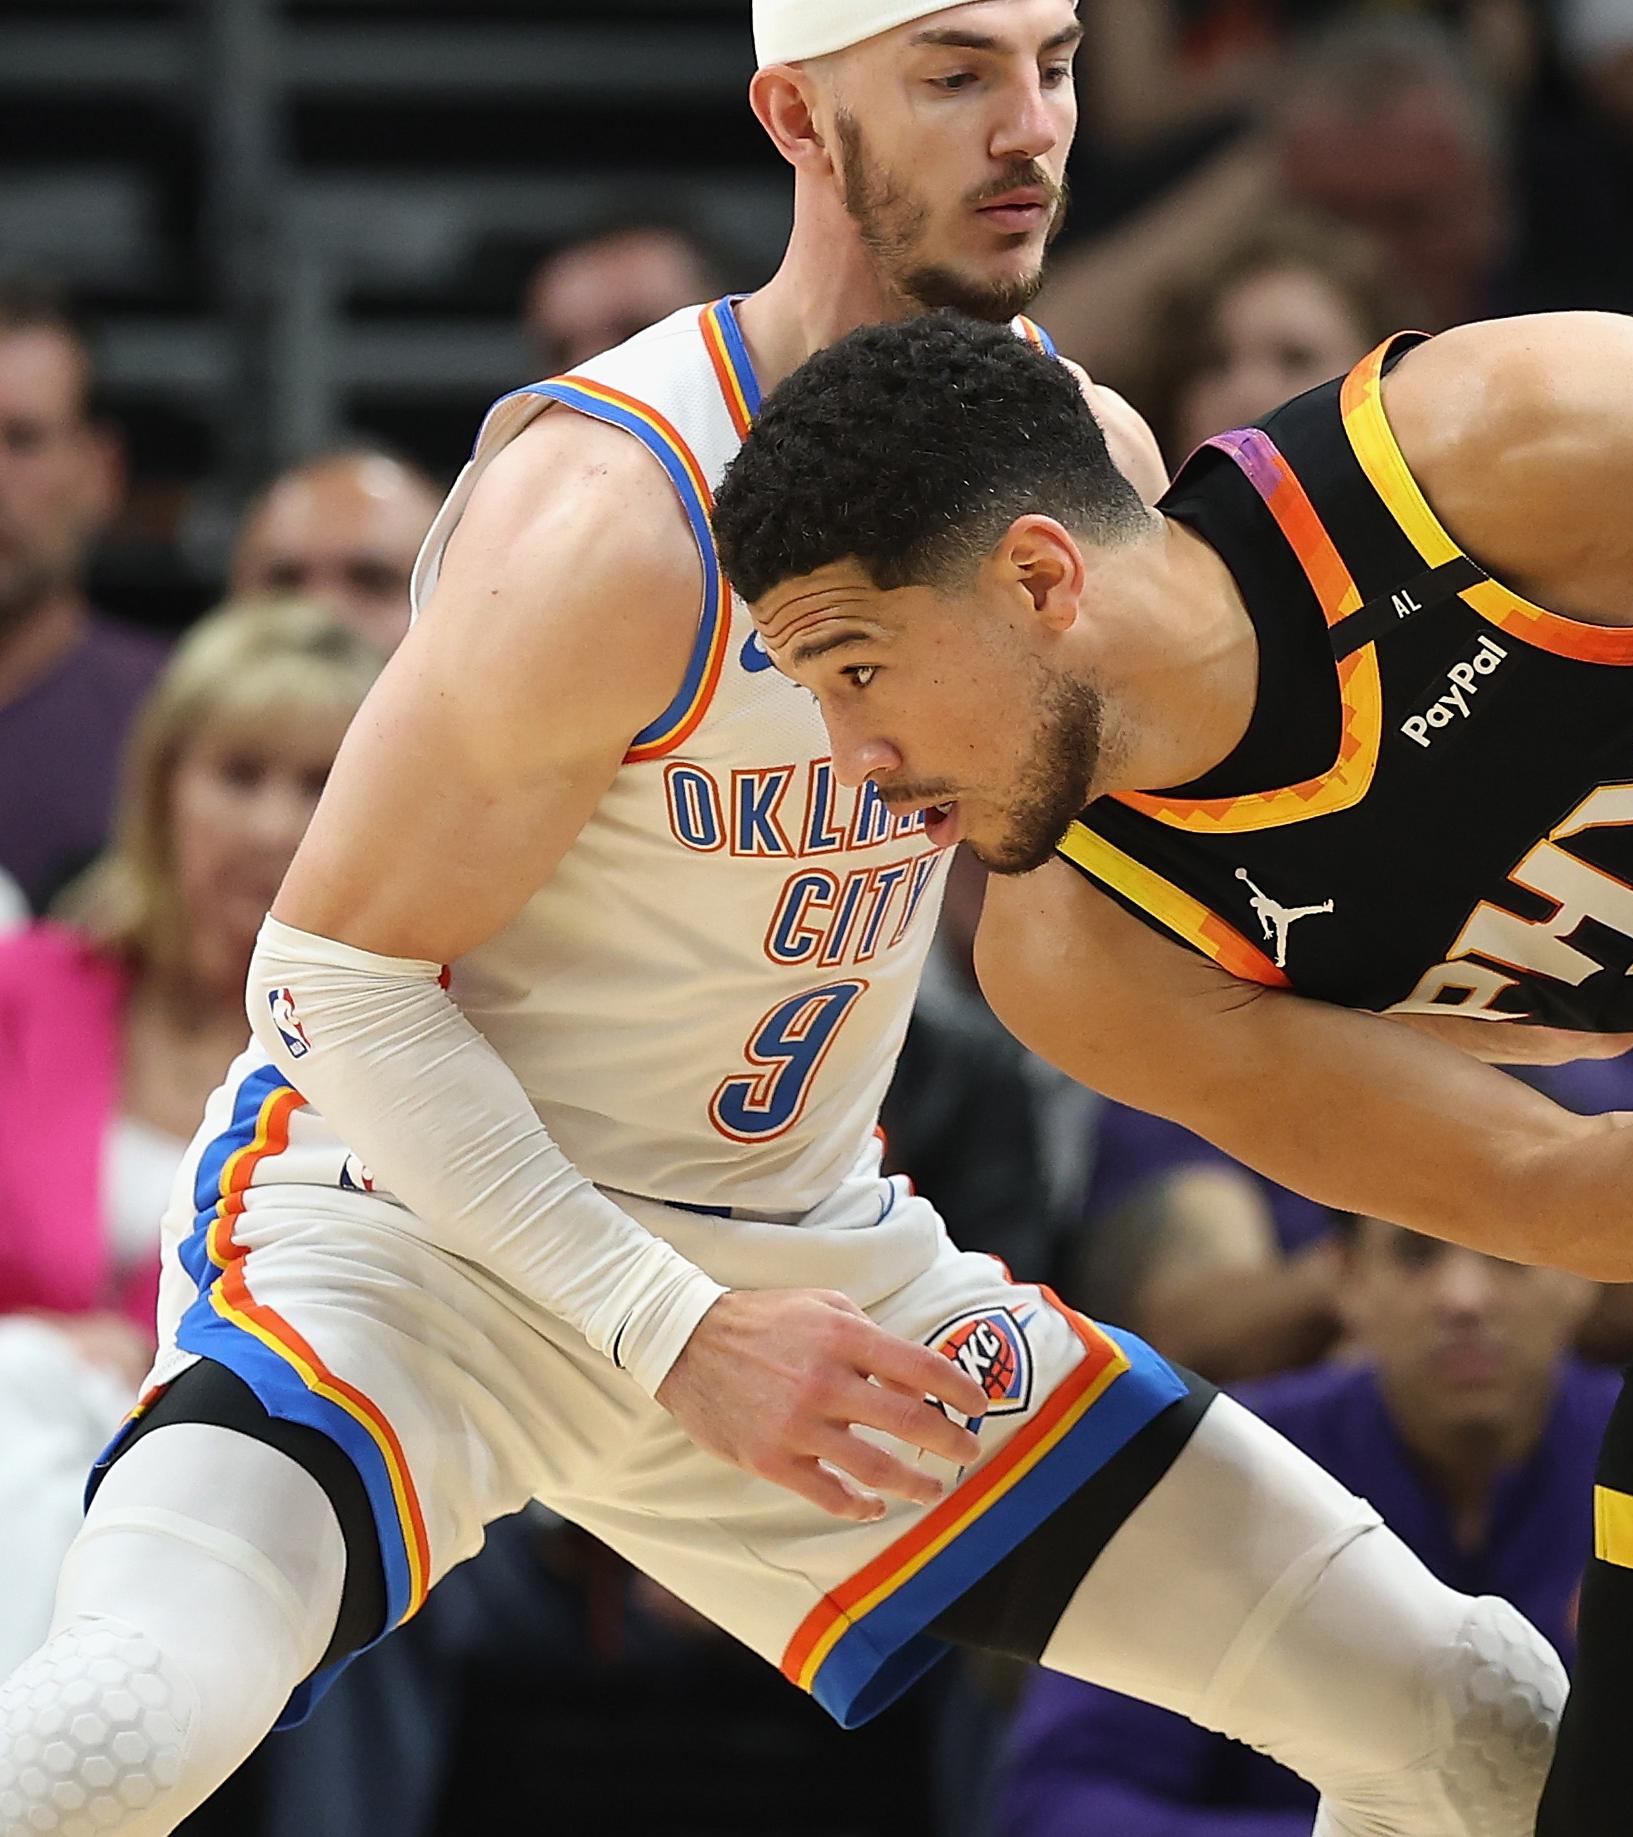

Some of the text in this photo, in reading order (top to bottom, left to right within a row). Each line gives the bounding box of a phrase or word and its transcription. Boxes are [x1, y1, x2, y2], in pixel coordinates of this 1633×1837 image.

[1391, 589, 1422, 619] AL
[1400, 635, 1508, 748] PayPal
[764, 849, 944, 968] CITY
[708, 978, 870, 1144] 9
